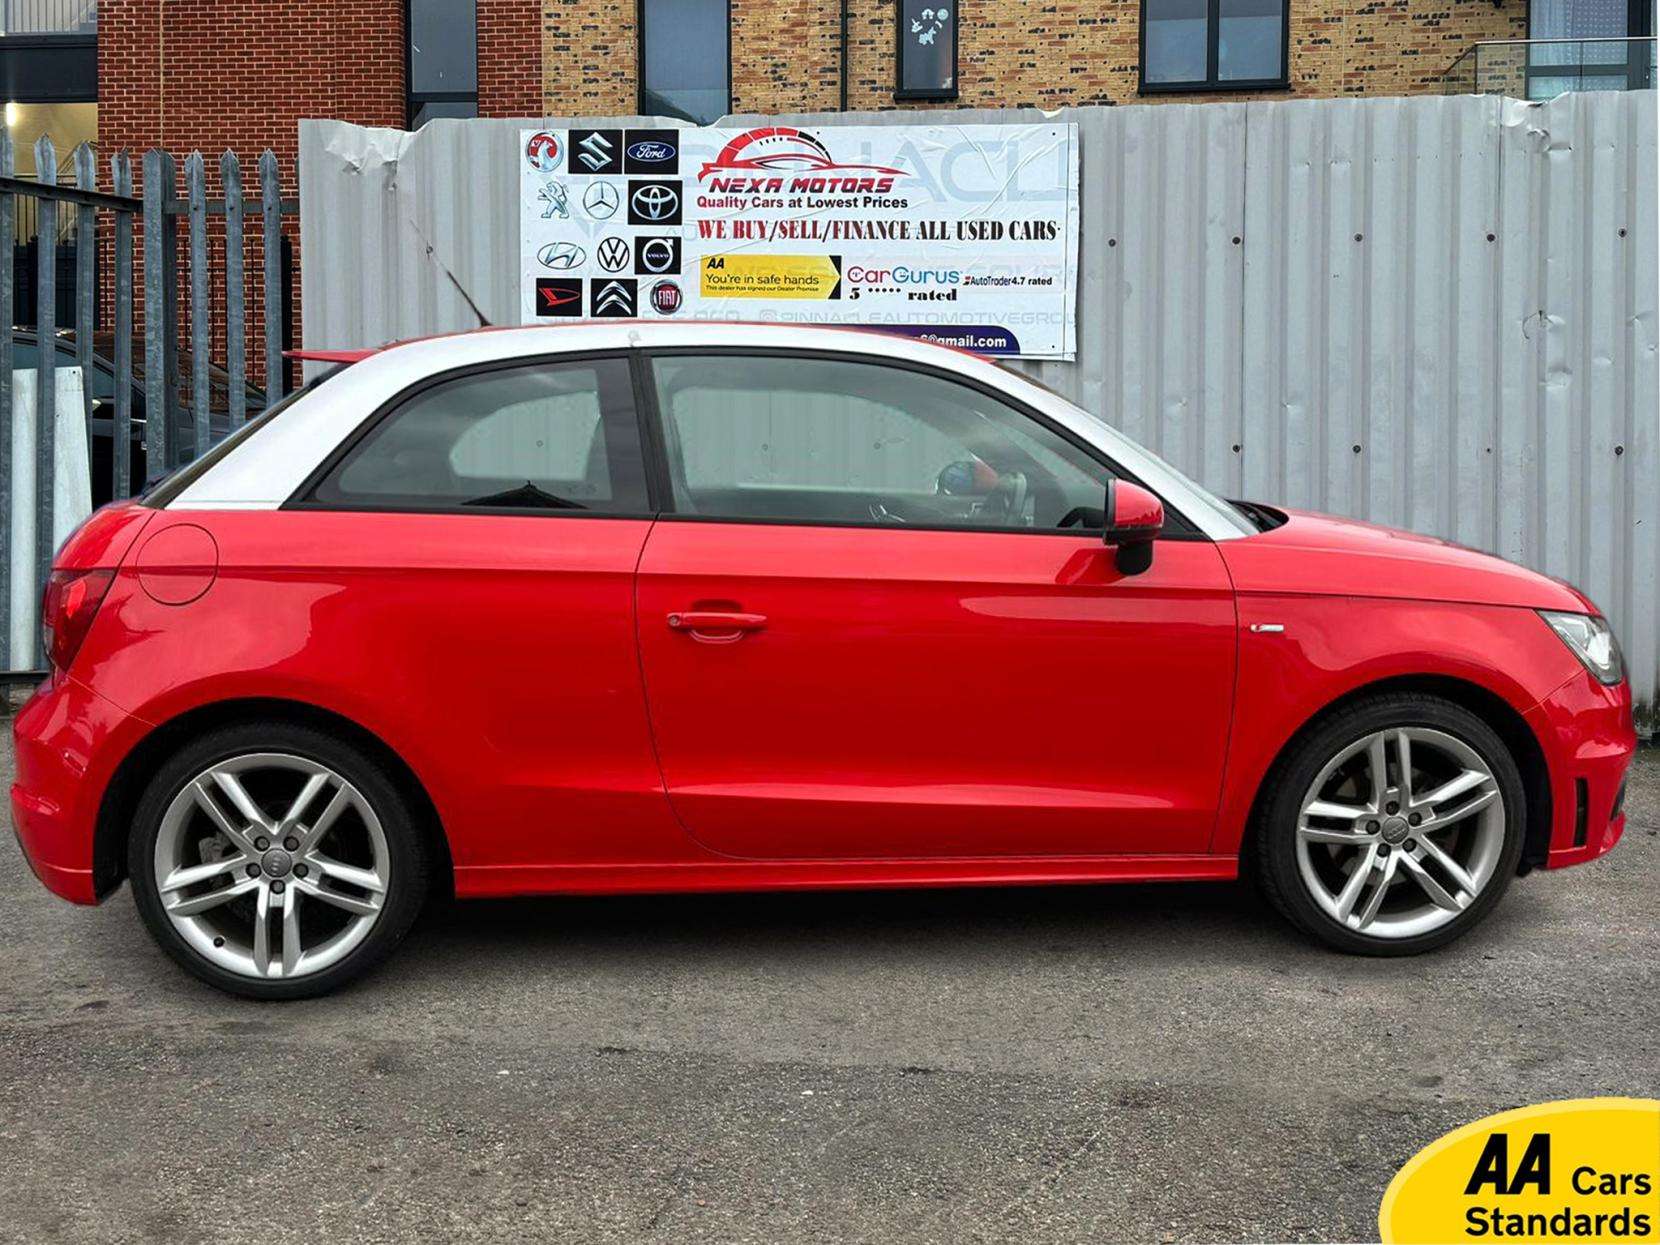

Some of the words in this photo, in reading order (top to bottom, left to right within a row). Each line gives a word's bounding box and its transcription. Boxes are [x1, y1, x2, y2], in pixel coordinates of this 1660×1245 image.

[636, 144, 666, 158] Ford
[709, 177, 782, 194] NEXA
[788, 177, 894, 194] MOTORS
[697, 196, 747, 210] Quality
[751, 196, 784, 209] Cars
[788, 197, 803, 208] at
[807, 196, 859, 209] Lowest
[863, 196, 908, 208] Prices
[698, 220, 727, 240] WE
[733, 219, 911, 242] BUY/SELL/FINANCE
[916, 220, 952, 240] ALL
[957, 220, 1004, 240] USED
[1008, 220, 1056, 240] CARS
[706, 257, 725, 269] AA
[705, 273, 741, 284] You're
[744, 274, 754, 284] in
[757, 274, 781, 284] safe
[783, 274, 820, 285] hands
[847, 265, 960, 284] CarGurus
[1028, 277, 1053, 286] rated
[658, 290, 677, 306] FIAT
[849, 287, 861, 300] 5
[907, 288, 958, 301] rated
